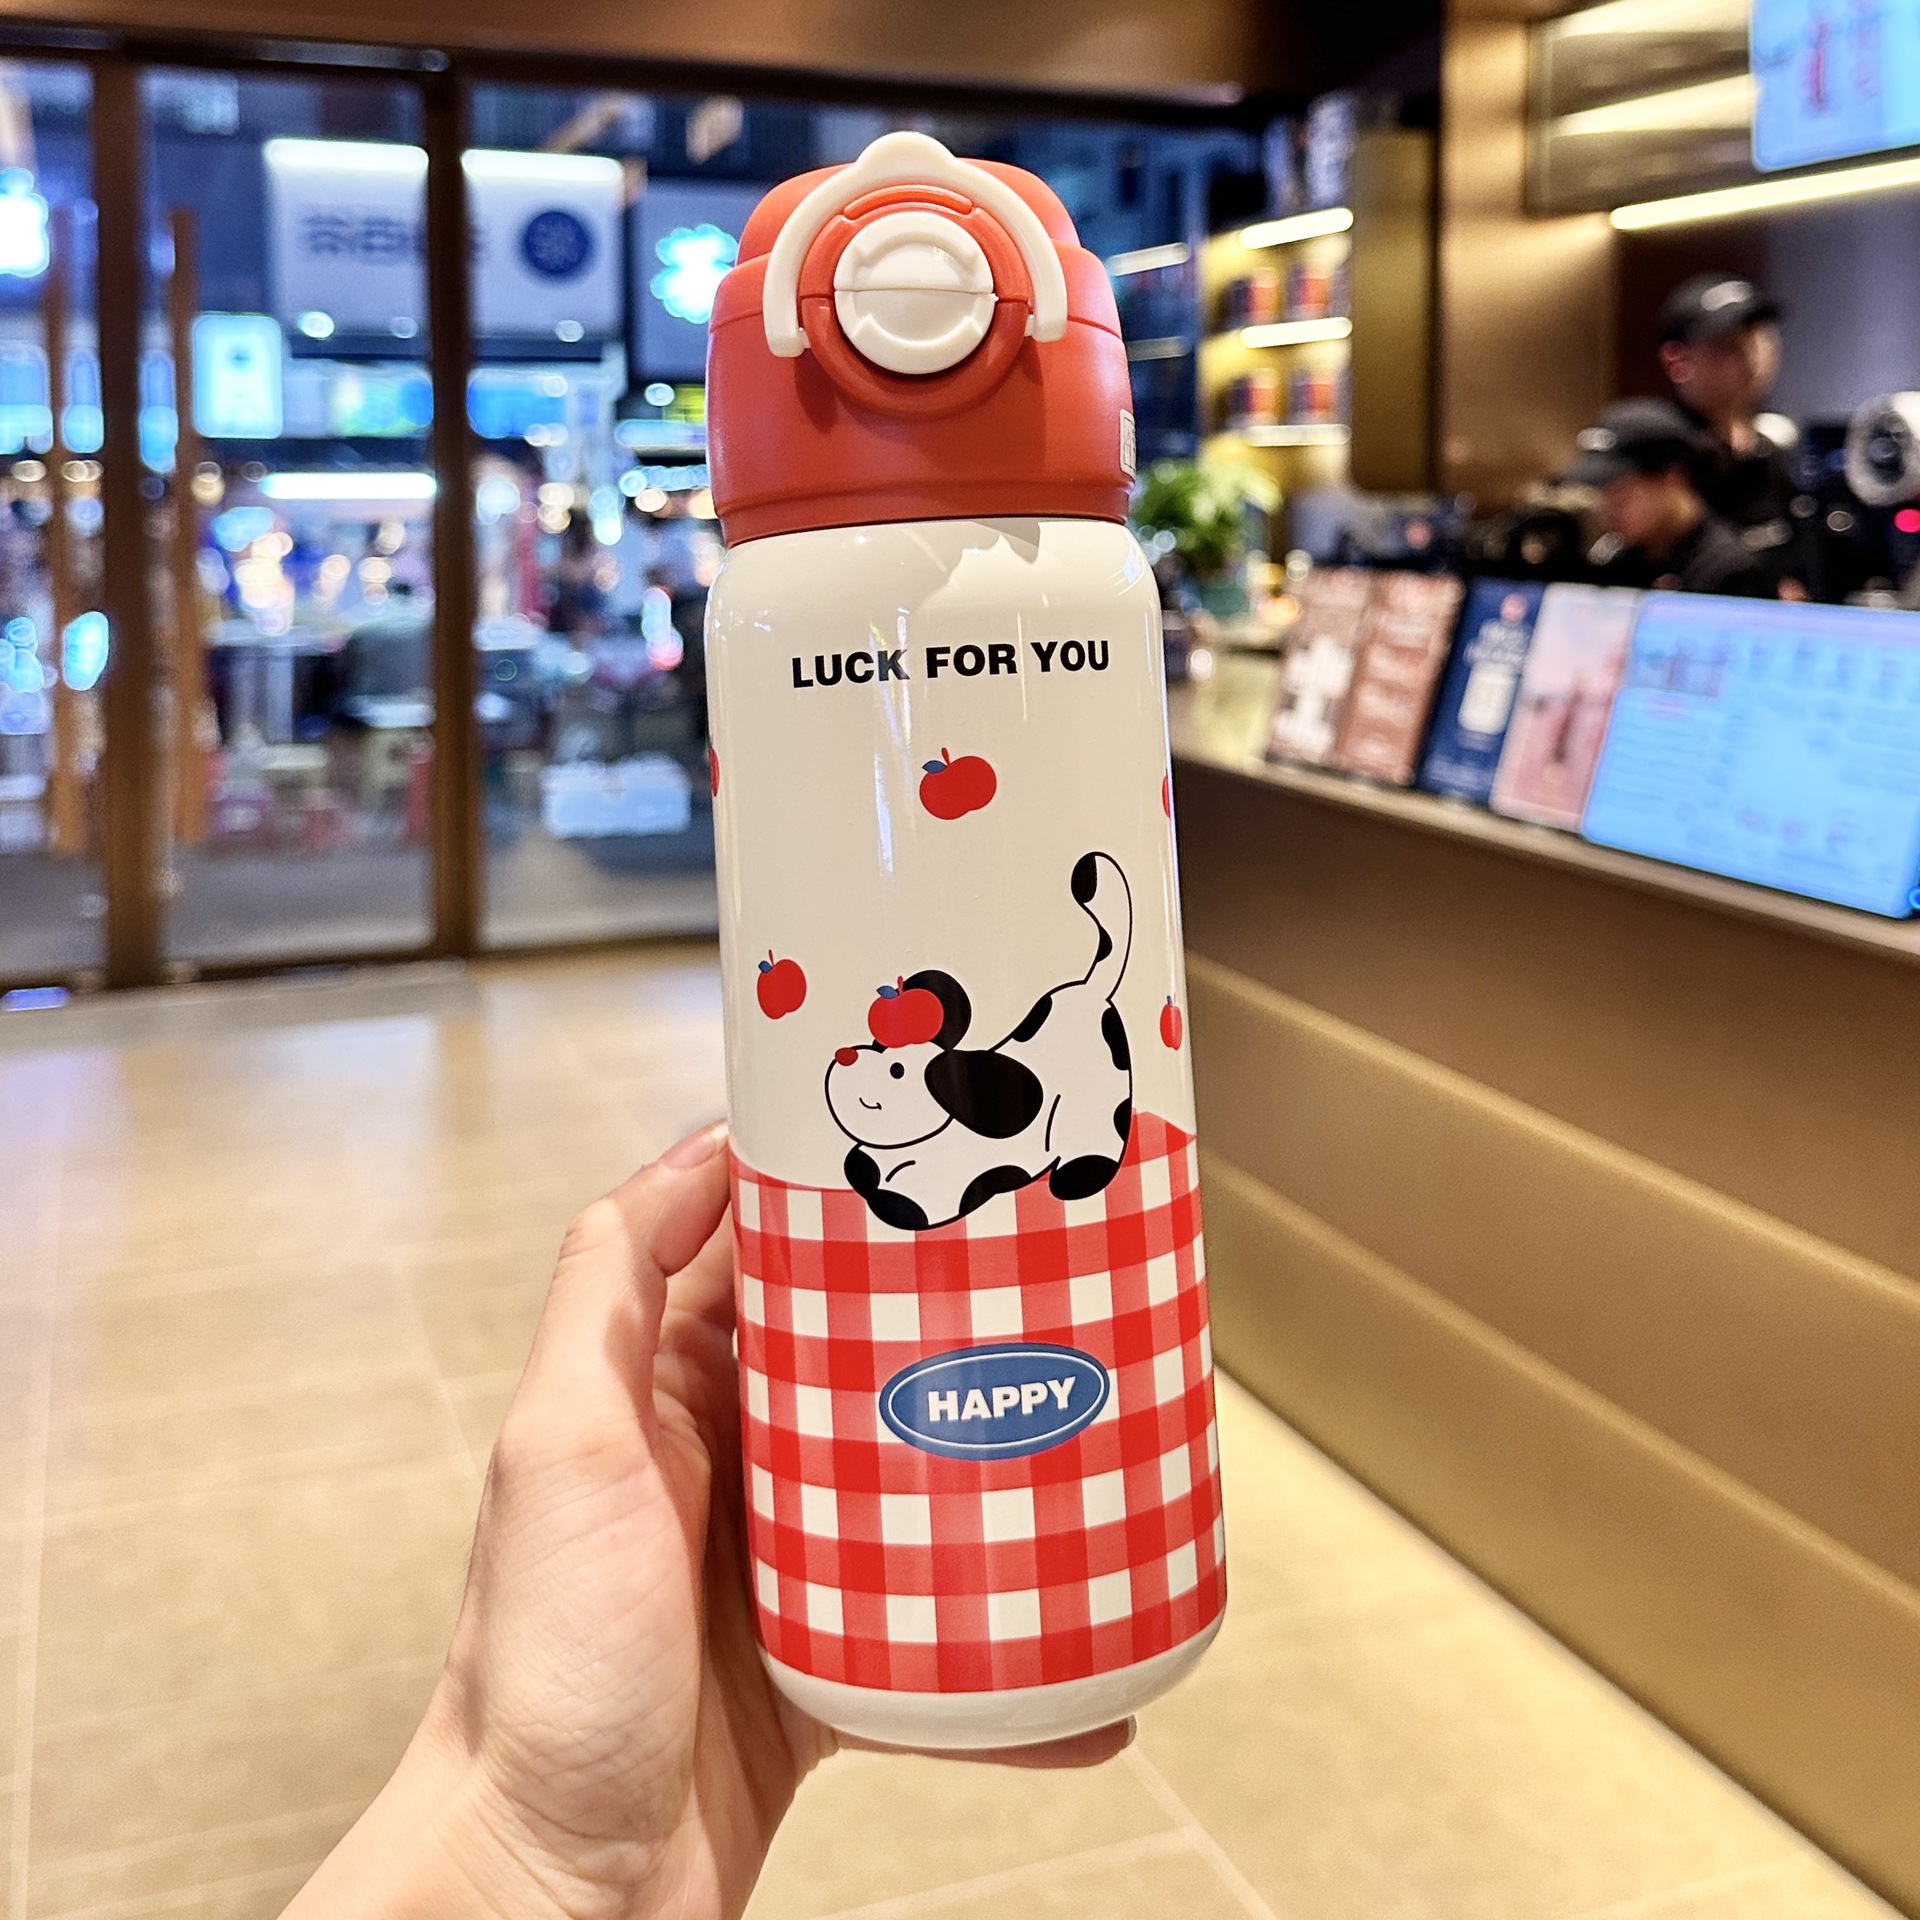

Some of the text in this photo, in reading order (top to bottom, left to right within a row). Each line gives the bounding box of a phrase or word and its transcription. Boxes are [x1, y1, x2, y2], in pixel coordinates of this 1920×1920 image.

[792, 640, 1109, 688] LUCK FOR YOU
[927, 1376, 1076, 1422] HAPPY
